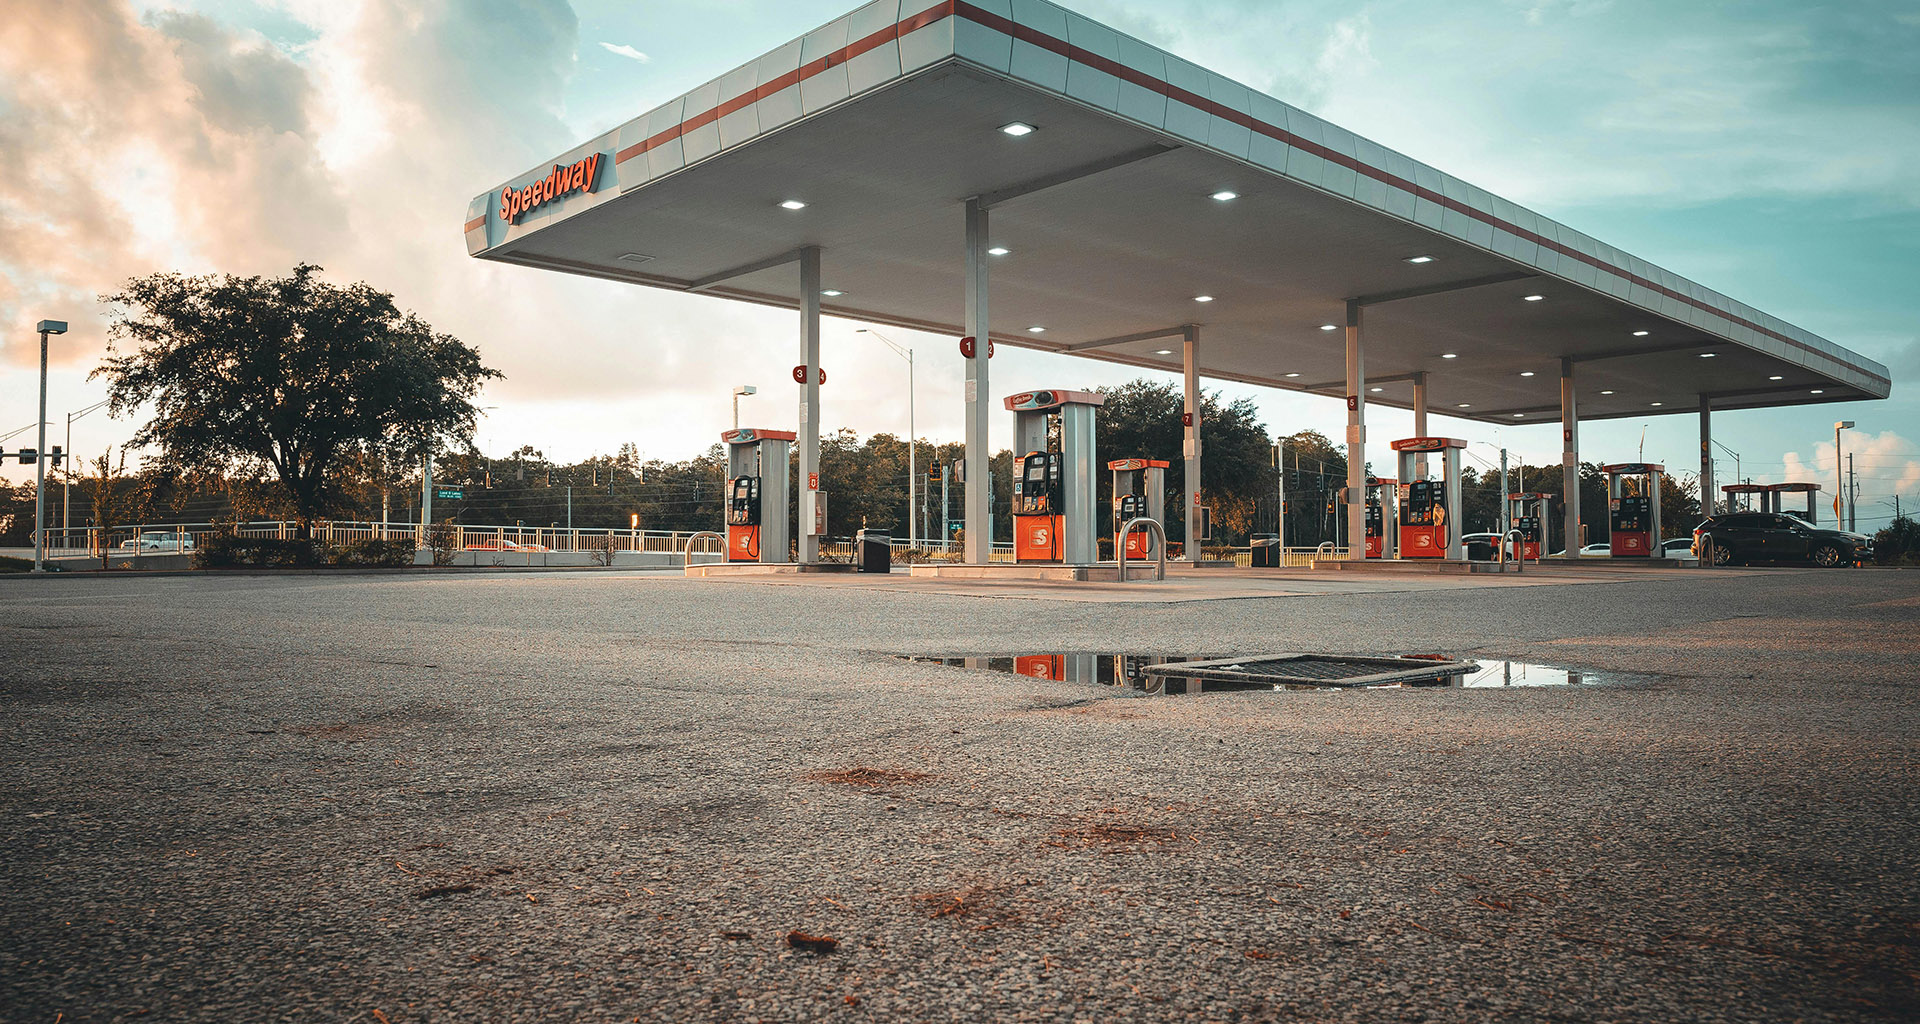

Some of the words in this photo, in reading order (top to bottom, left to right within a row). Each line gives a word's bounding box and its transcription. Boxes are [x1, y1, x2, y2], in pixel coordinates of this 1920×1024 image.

[499, 152, 601, 225] Speedway
[966, 342, 970, 351] 1
[796, 369, 803, 378] 3
[1034, 529, 1048, 545] S
[1418, 535, 1430, 547] S
